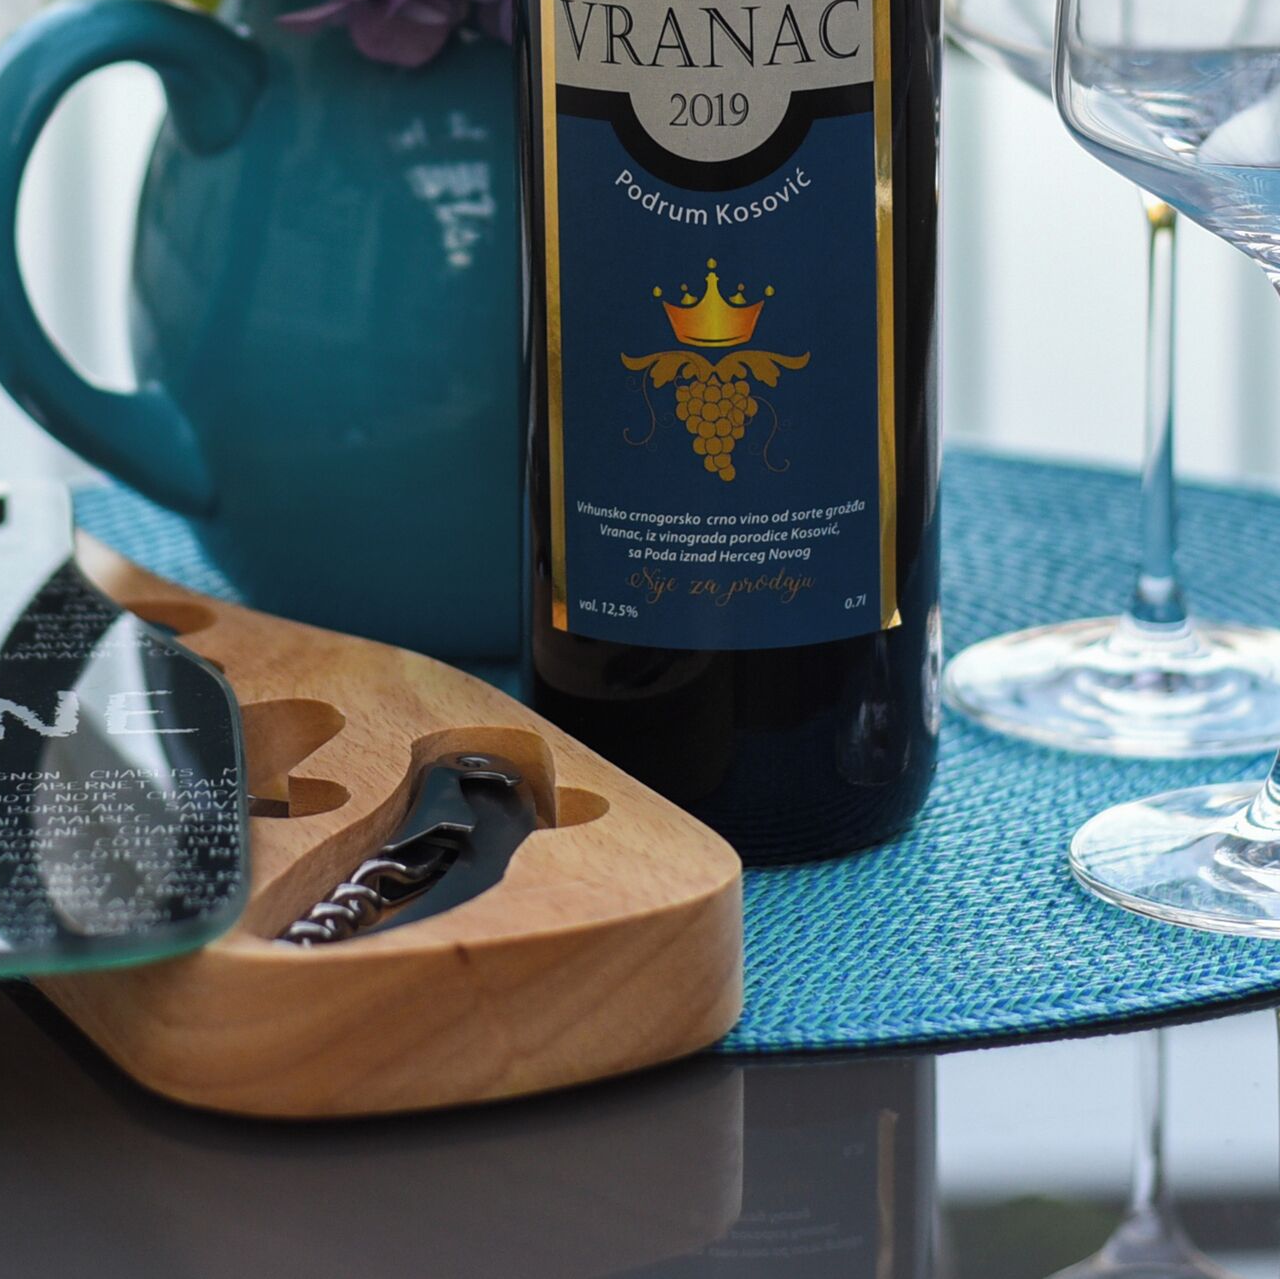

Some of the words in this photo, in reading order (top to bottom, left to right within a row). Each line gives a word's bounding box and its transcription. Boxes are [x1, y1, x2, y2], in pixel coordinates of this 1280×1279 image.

[669, 92, 750, 127] 2019
[615, 169, 708, 225] Podrum
[716, 167, 811, 225] Kosović
[577, 500, 627, 520] Vrhunsko
[629, 512, 701, 526] crnogorsko
[707, 515, 736, 525] crno
[740, 512, 771, 525] vino
[771, 509, 790, 523] od
[791, 508, 823, 521] sorte
[600, 523, 643, 541] Vranac,
[646, 529, 657, 541] iz
[659, 531, 726, 546] vinograda
[729, 530, 788, 546] porodice
[790, 522, 840, 540] Kosović,
[628, 548, 642, 558] sa
[644, 547, 677, 561] Poda
[679, 550, 717, 562] iznad
[719, 550, 766, 564] Herceg
[768, 547, 811, 560] Novog
[625, 566, 678, 604] Nije
[689, 578, 720, 594] za
[715, 567, 816, 607] prodaju
[579, 598, 598, 613] vol.
[601, 602, 638, 618] 12,5%
[90, 768, 194, 780] CHABLIS
[16, 780, 150, 793] CABERNET
[55, 792, 118, 803] NOIR
[7, 802, 135, 815] BORDEAUX
[47, 813, 152, 825] MALBEC
